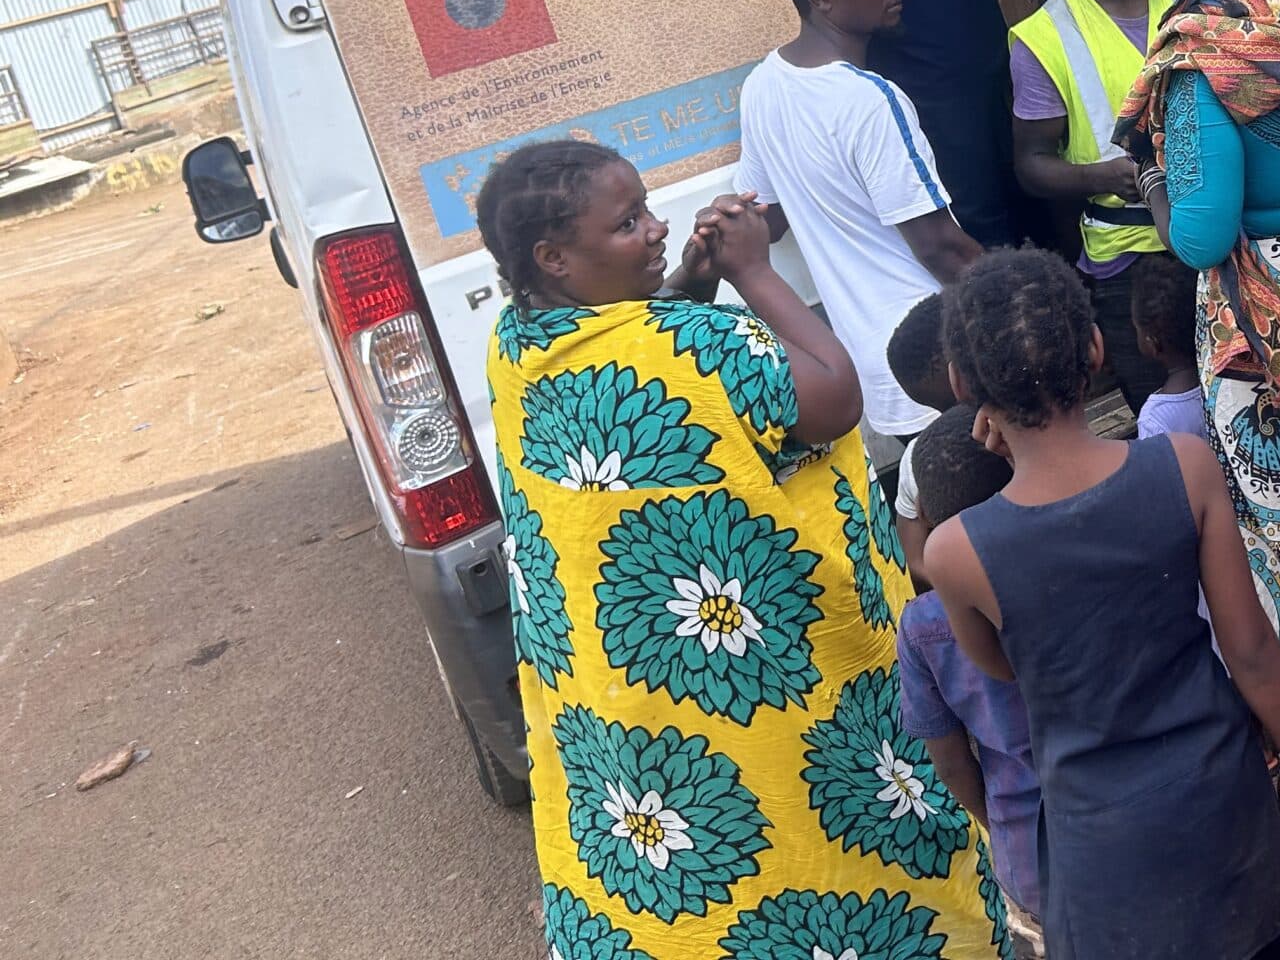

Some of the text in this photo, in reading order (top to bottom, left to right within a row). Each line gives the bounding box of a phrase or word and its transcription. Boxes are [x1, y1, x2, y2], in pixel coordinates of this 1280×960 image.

[401, 50, 604, 120] Agence de l'Environnement
[407, 129, 424, 142] et
[428, 122, 445, 136] de
[449, 115, 463, 129] la
[529, 90, 548, 104] de
